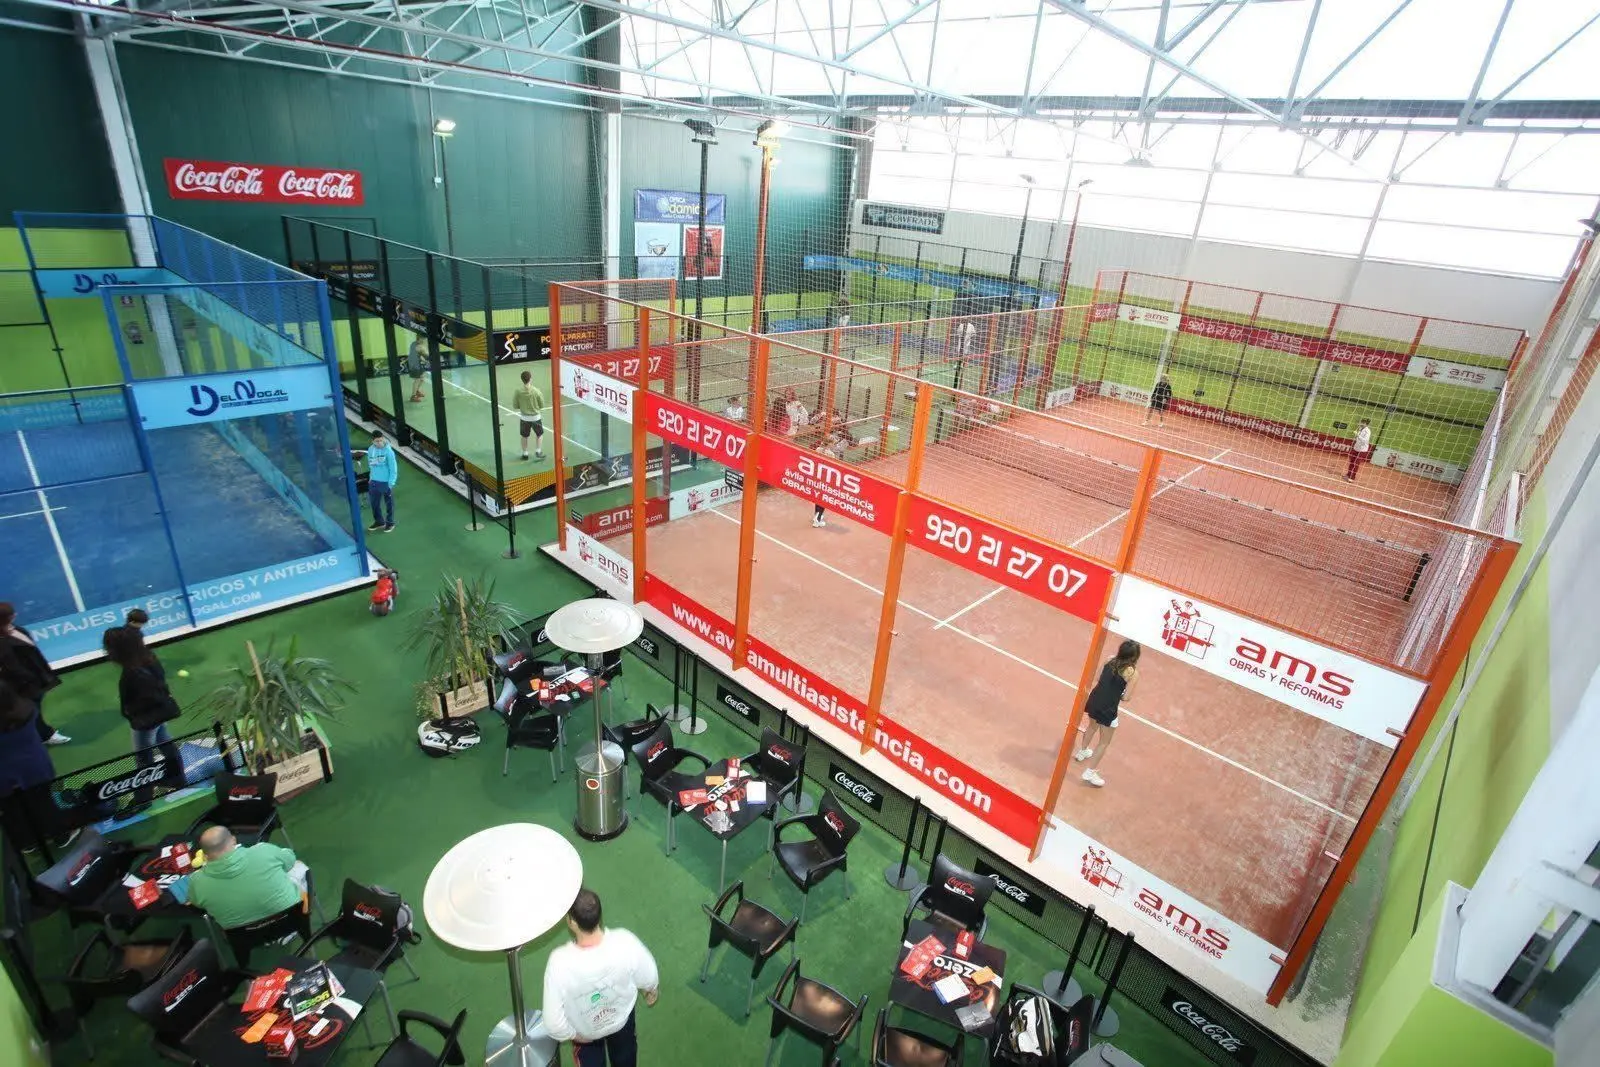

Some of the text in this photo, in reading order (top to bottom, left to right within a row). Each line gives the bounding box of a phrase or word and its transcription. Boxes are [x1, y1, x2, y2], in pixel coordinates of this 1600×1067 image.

[174, 163, 356, 199] Coca-Cola Coca-Cola
[887, 213, 938, 227] POWERADE
[1144, 312, 1169, 321] ams
[564, 343, 594, 352] FACTORY
[1331, 347, 1352, 360] 920
[1382, 357, 1397, 368] 07
[623, 358, 640, 376] 27
[1449, 367, 1487, 381] ams
[594, 383, 628, 406] ams
[657, 407, 746, 460] 920 21 27 07
[798, 455, 861, 494] ams
[1409, 459, 1445, 474] ams
[781, 477, 875, 522] OBRAS Y REFORMAS
[784, 468, 874, 511] ávila multiasistencia
[598, 553, 629, 580] ams
[925, 514, 1088, 598] 920 21 27 07
[30, 611, 117, 642] NTAJES
[249, 575, 259, 587] Y
[263, 555, 338, 584] ANTENAS
[1229, 657, 1344, 710] OBRAS Y REFORMAS
[1236, 637, 1355, 697] ams
[672, 602, 992, 814] www.avamultiasistencia.com
[724, 694, 751, 716] Coca-Cola
[98, 762, 168, 800] Coca-Cola
[834, 771, 876, 803] Coca-Cola
[987, 873, 1030, 903] Coca-Cola
[1133, 900, 1223, 960] OBRAS Y REFORMAS
[1138, 887, 1231, 951] ams
[933, 956, 975, 978] zero
[1172, 1001, 1246, 1052] Coca-Cola
